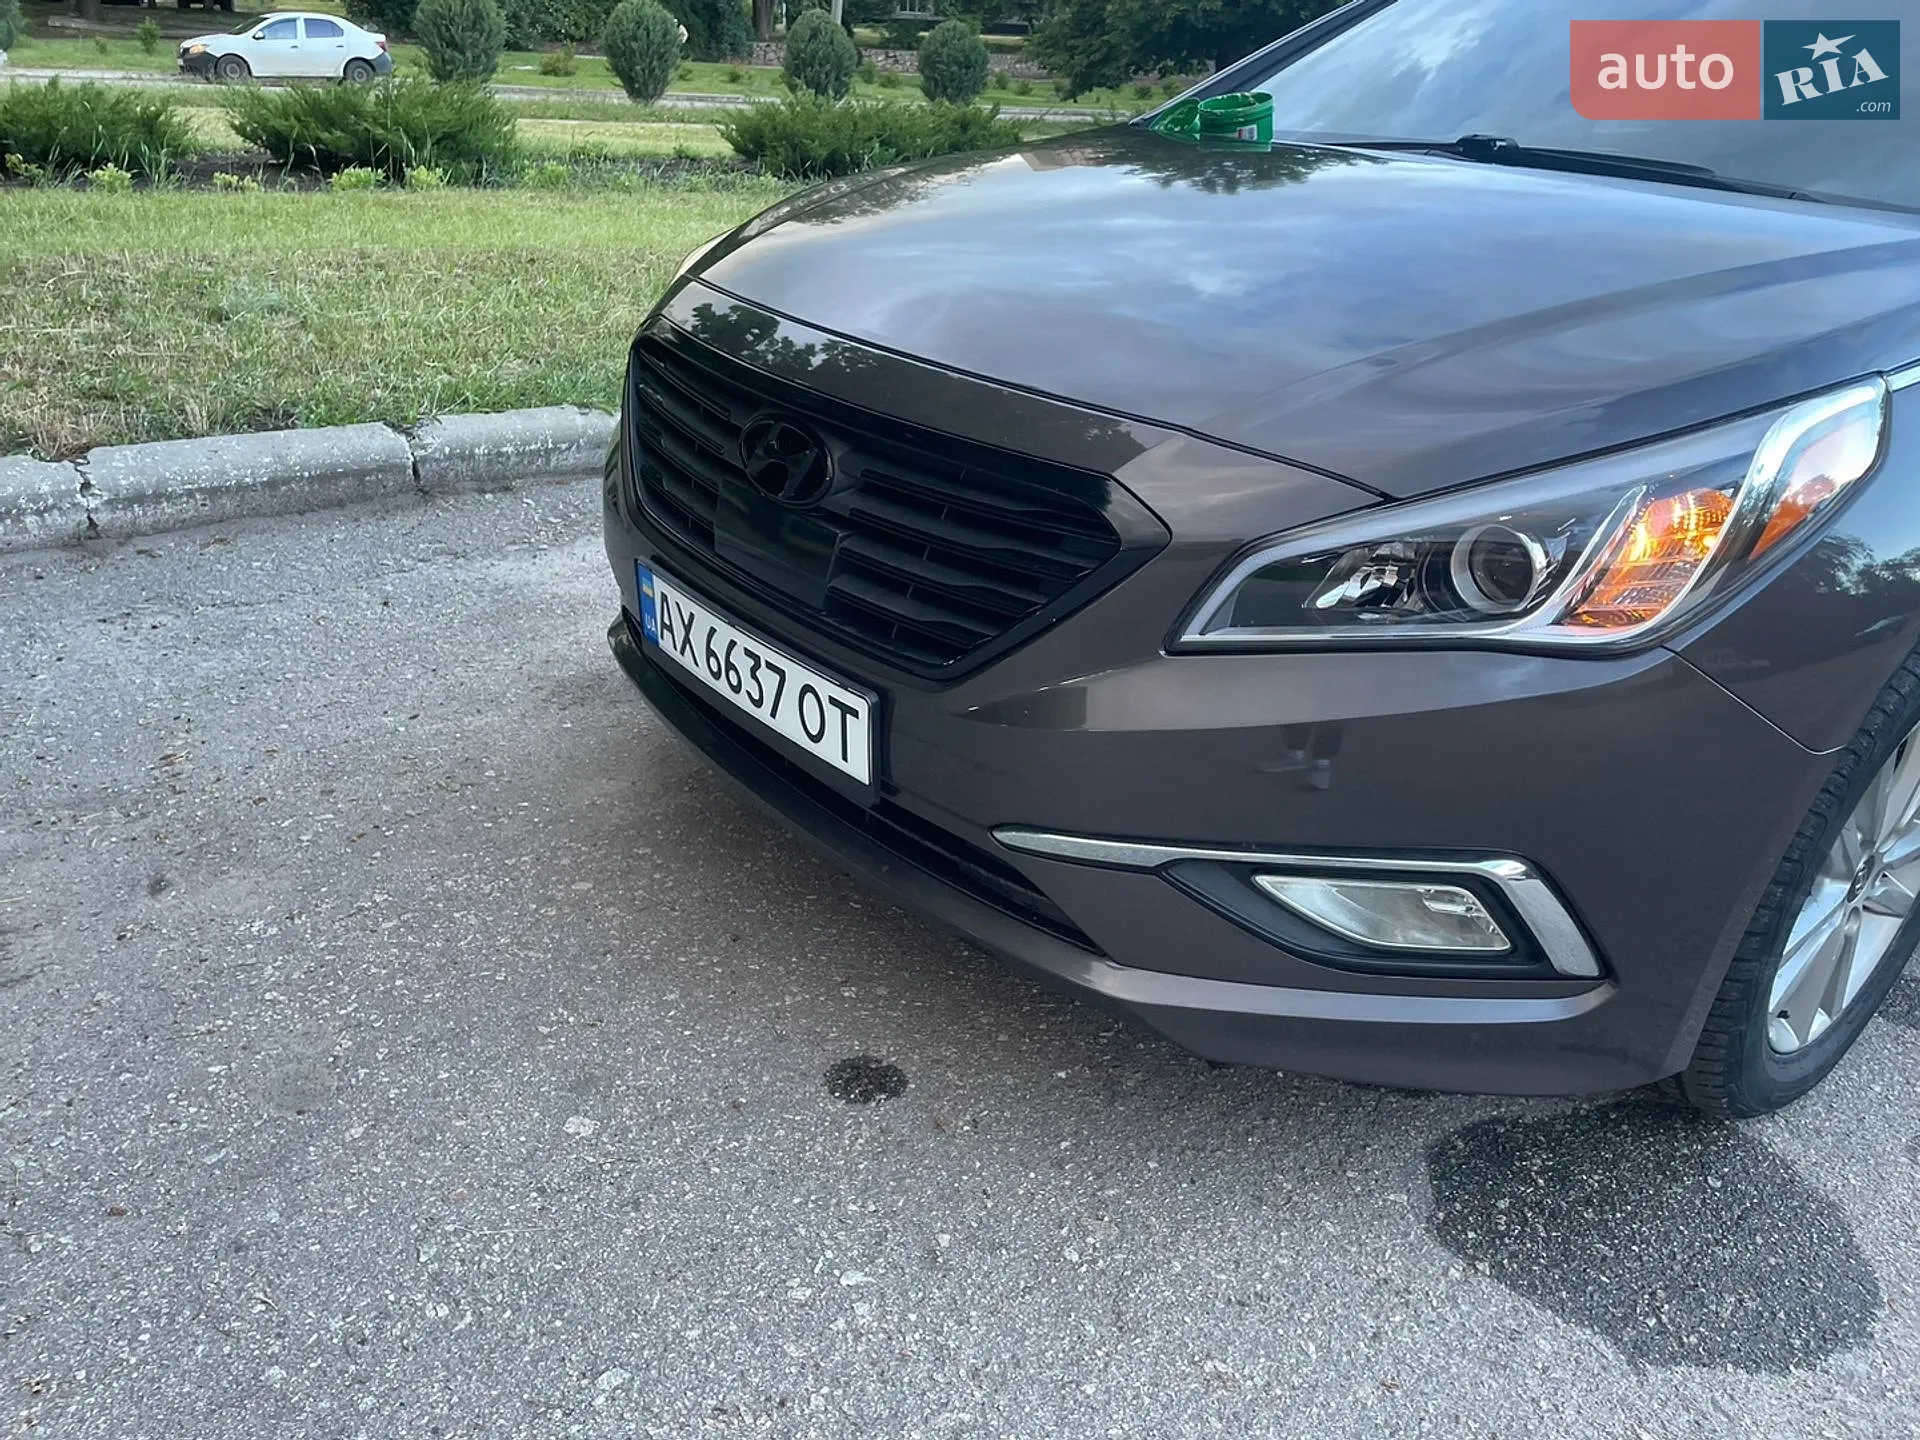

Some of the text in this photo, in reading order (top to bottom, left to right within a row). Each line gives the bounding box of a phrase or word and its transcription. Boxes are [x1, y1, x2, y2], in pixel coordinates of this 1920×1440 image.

[645, 612, 656, 632] UA
[660, 591, 859, 763] AX 6637 OT
